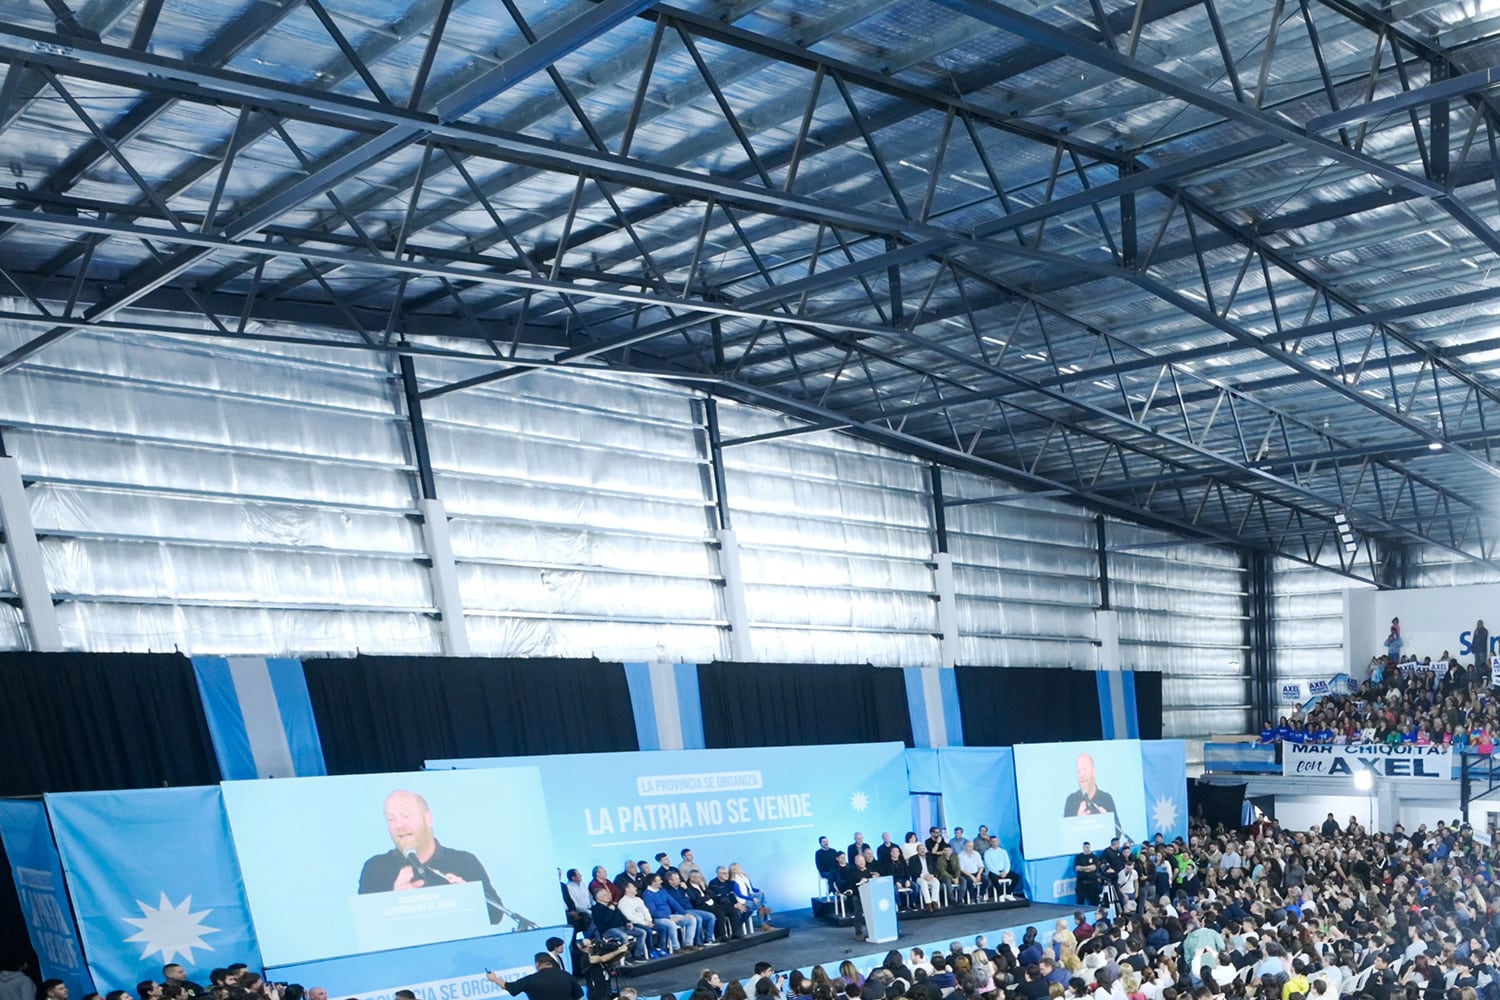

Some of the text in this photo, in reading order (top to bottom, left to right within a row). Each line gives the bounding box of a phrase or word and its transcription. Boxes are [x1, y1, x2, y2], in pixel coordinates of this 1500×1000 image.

[1310, 680, 1327, 689] AXEL
[1297, 756, 1440, 777] con AXEL
[641, 774, 758, 793] LA PROVINCIA SE ORGANIZA
[584, 793, 813, 836] LA PATRIA NO SE VENDE
[440, 983, 459, 1000] SE
